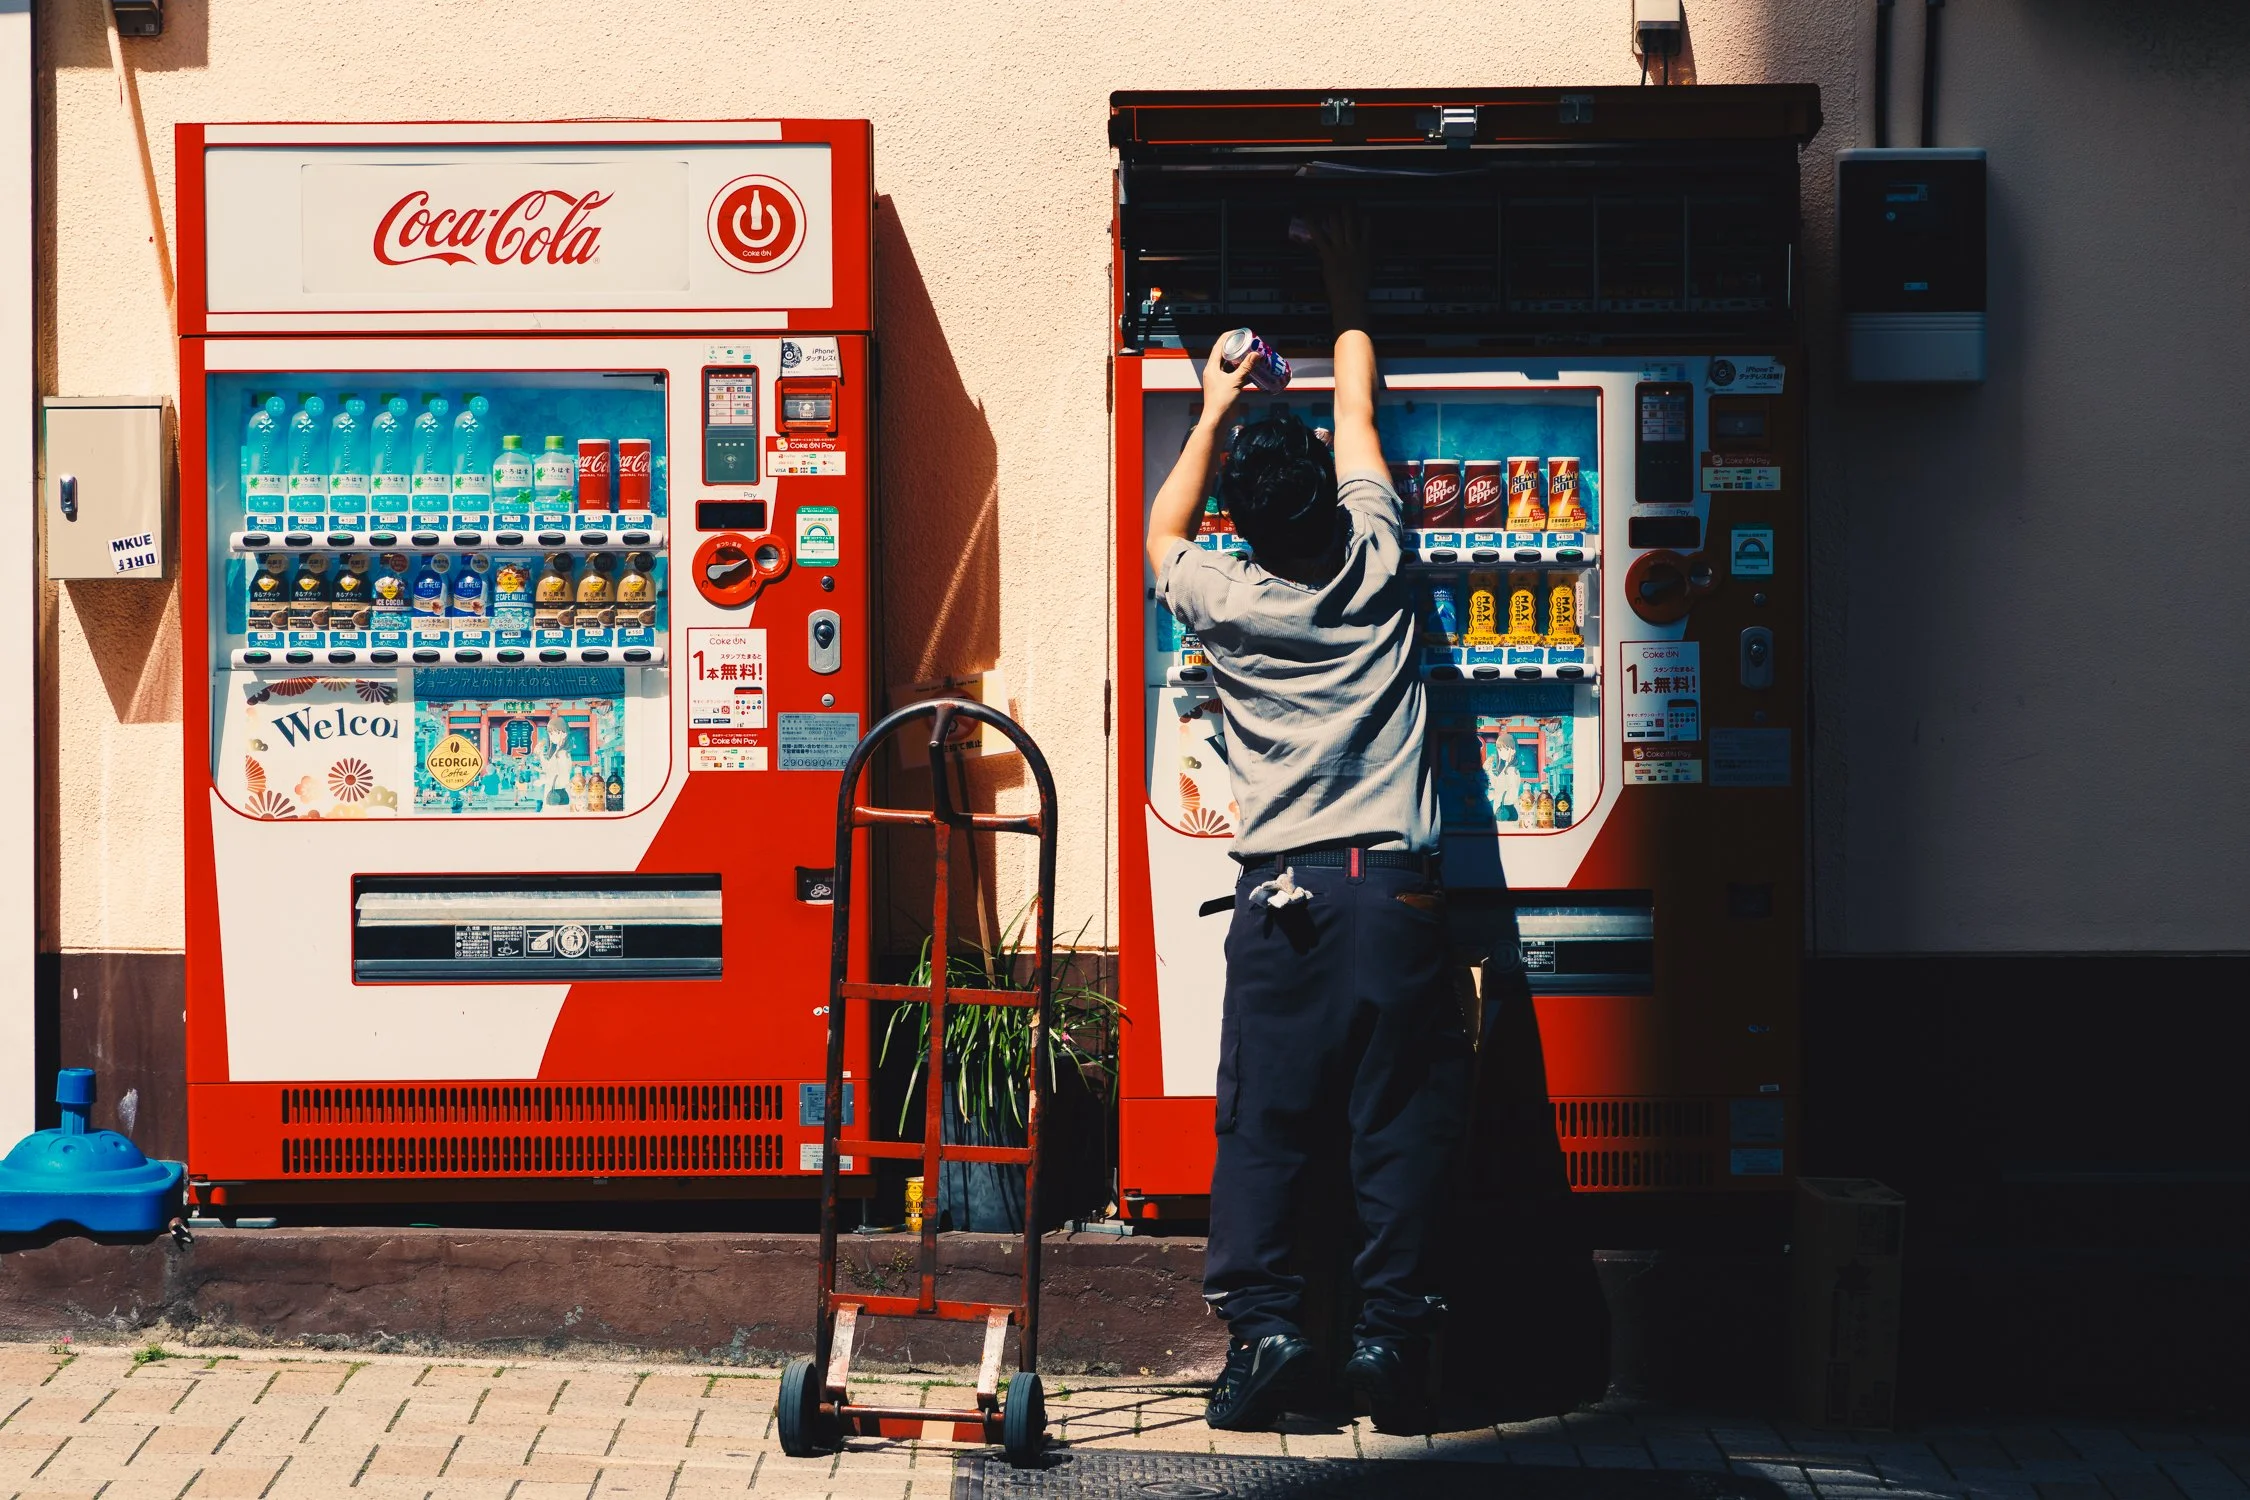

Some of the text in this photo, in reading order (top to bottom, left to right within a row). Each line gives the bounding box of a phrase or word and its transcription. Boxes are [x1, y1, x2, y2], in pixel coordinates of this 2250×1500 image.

[373, 190, 616, 266] Coca-Cola
[789, 439, 808, 449] Coke
[821, 439, 836, 451] Pay
[1756, 457, 1771, 466] Pay
[1512, 471, 1537, 484] REAL
[1553, 471, 1578, 485] REAL
[1433, 479, 1448, 494] Dr
[1475, 479, 1490, 494] Dr
[1513, 480, 1537, 493] GOLD
[1553, 481, 1577, 494] GOLD
[743, 491, 757, 499] Pay
[1425, 484, 1457, 503] Pepper
[1468, 484, 1499, 503] Pepper
[112, 534, 153, 552] MKUE
[1482, 595, 1491, 621] MAX
[1521, 595, 1530, 621] MAX
[1562, 596, 1571, 622] MAX
[709, 637, 731, 645] Coke
[1642, 651, 1665, 659] Coke
[743, 738, 758, 747] Pay
[430, 757, 479, 768] GEORGIA
[440, 769, 469, 779] Coffee
